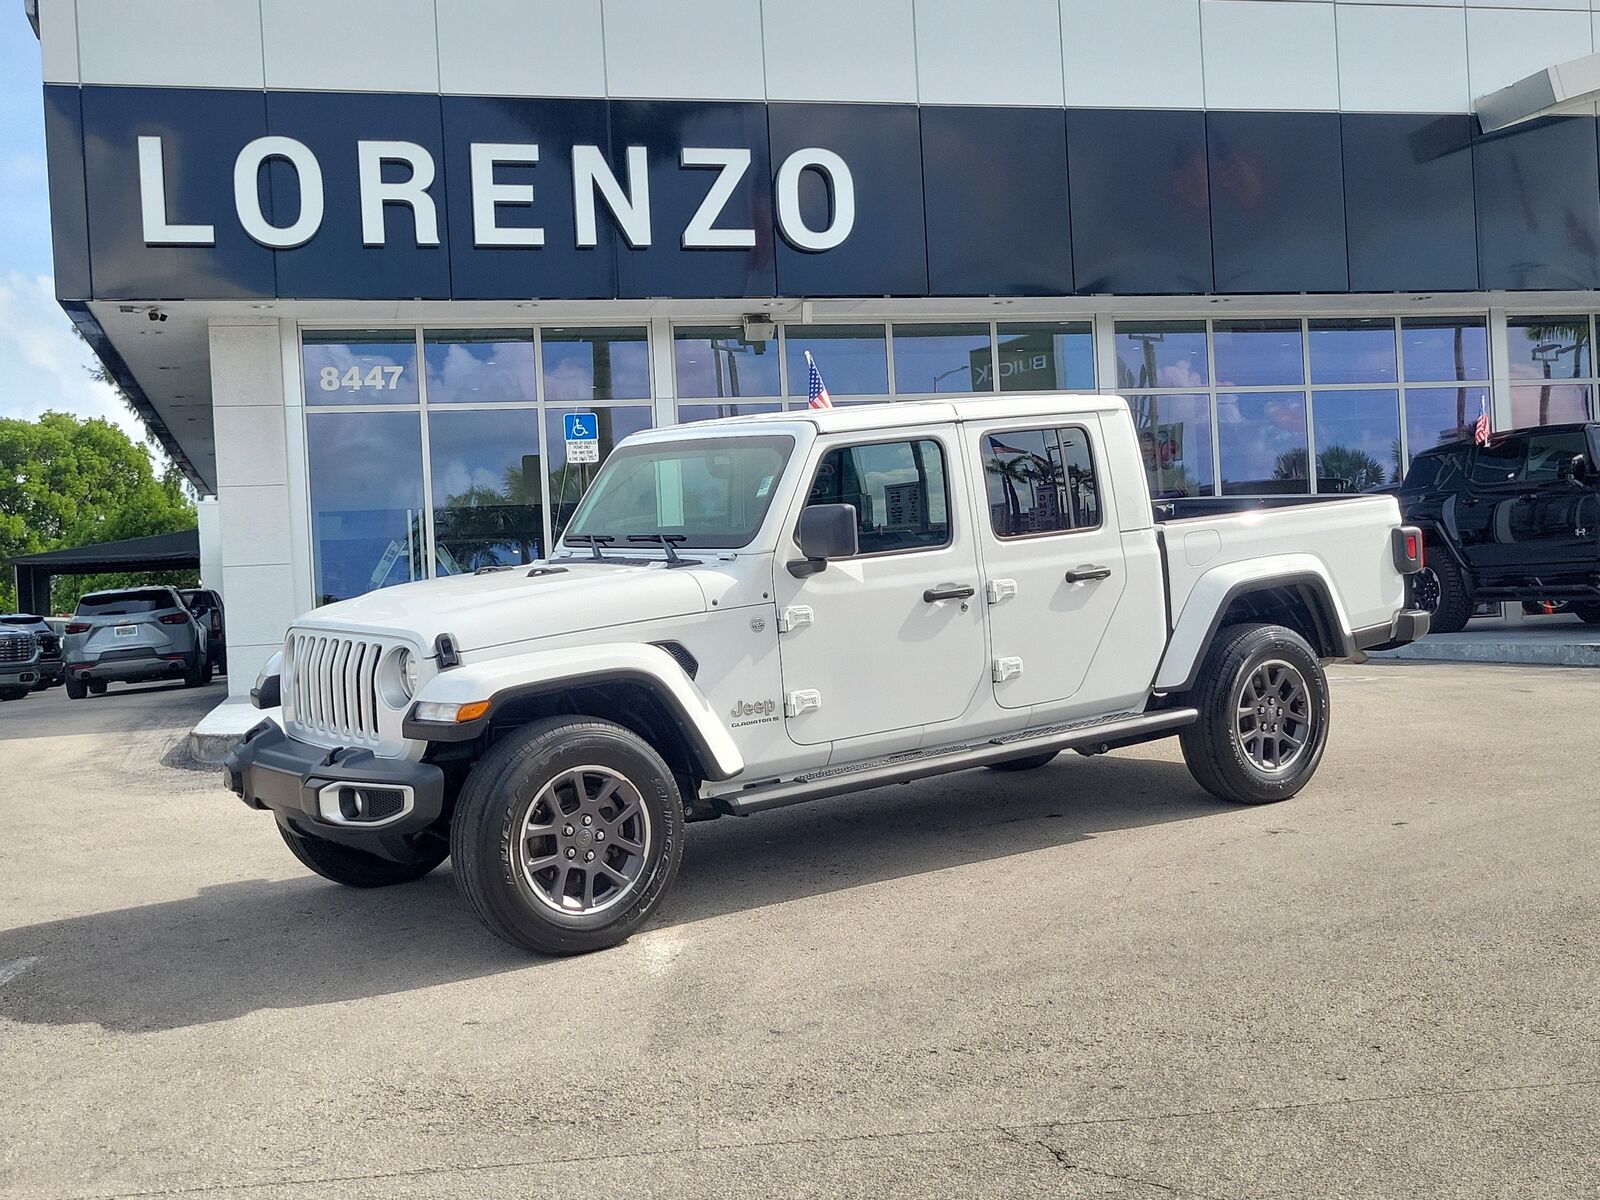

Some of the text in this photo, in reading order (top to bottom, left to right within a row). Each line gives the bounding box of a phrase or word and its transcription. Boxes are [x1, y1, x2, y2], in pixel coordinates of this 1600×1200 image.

[137, 134, 856, 252] LORENZO
[320, 365, 404, 391] 8447
[731, 700, 776, 717] Jeep
[731, 717, 772, 728] GLADIATOR
